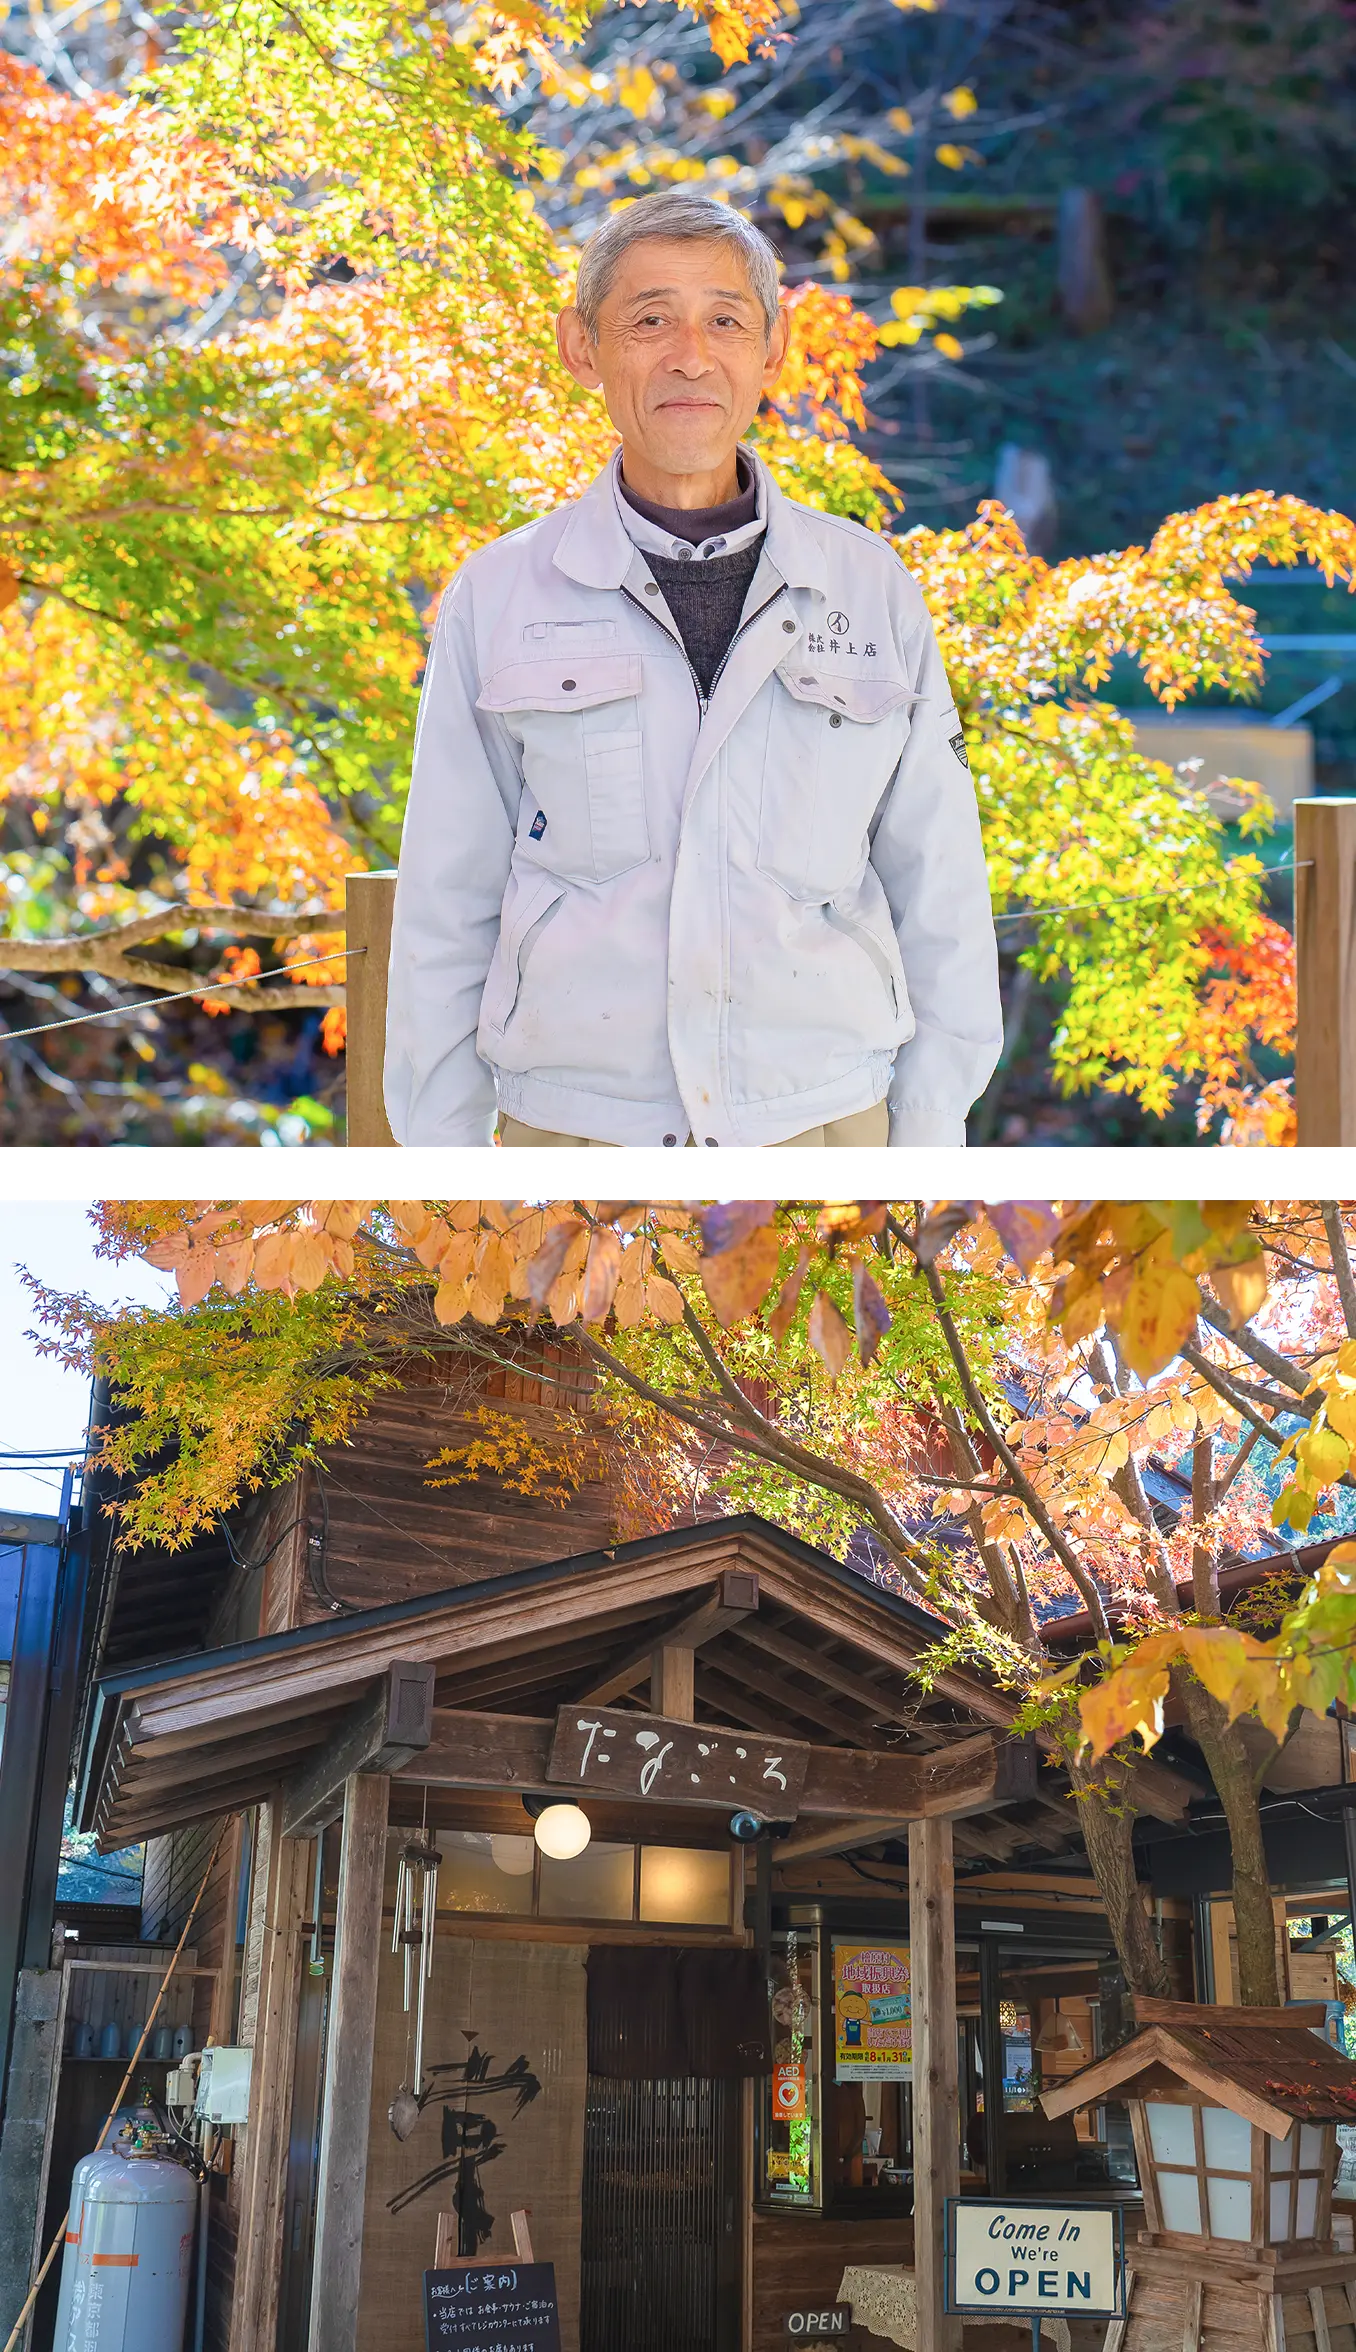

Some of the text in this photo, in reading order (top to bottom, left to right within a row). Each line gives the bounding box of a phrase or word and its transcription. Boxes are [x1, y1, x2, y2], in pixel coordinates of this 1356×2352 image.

[829, 638, 877, 657] 井上店
[842, 1964, 910, 1983] 地域振興券
[861, 1983, 891, 1994] 取扱店
[778, 2066, 800, 2077] AED
[988, 2214, 1081, 2242] Come In
[1011, 2246, 1059, 2262] We're
[974, 2267, 1091, 2299] OPEN
[788, 2312, 843, 2333] OPEN
